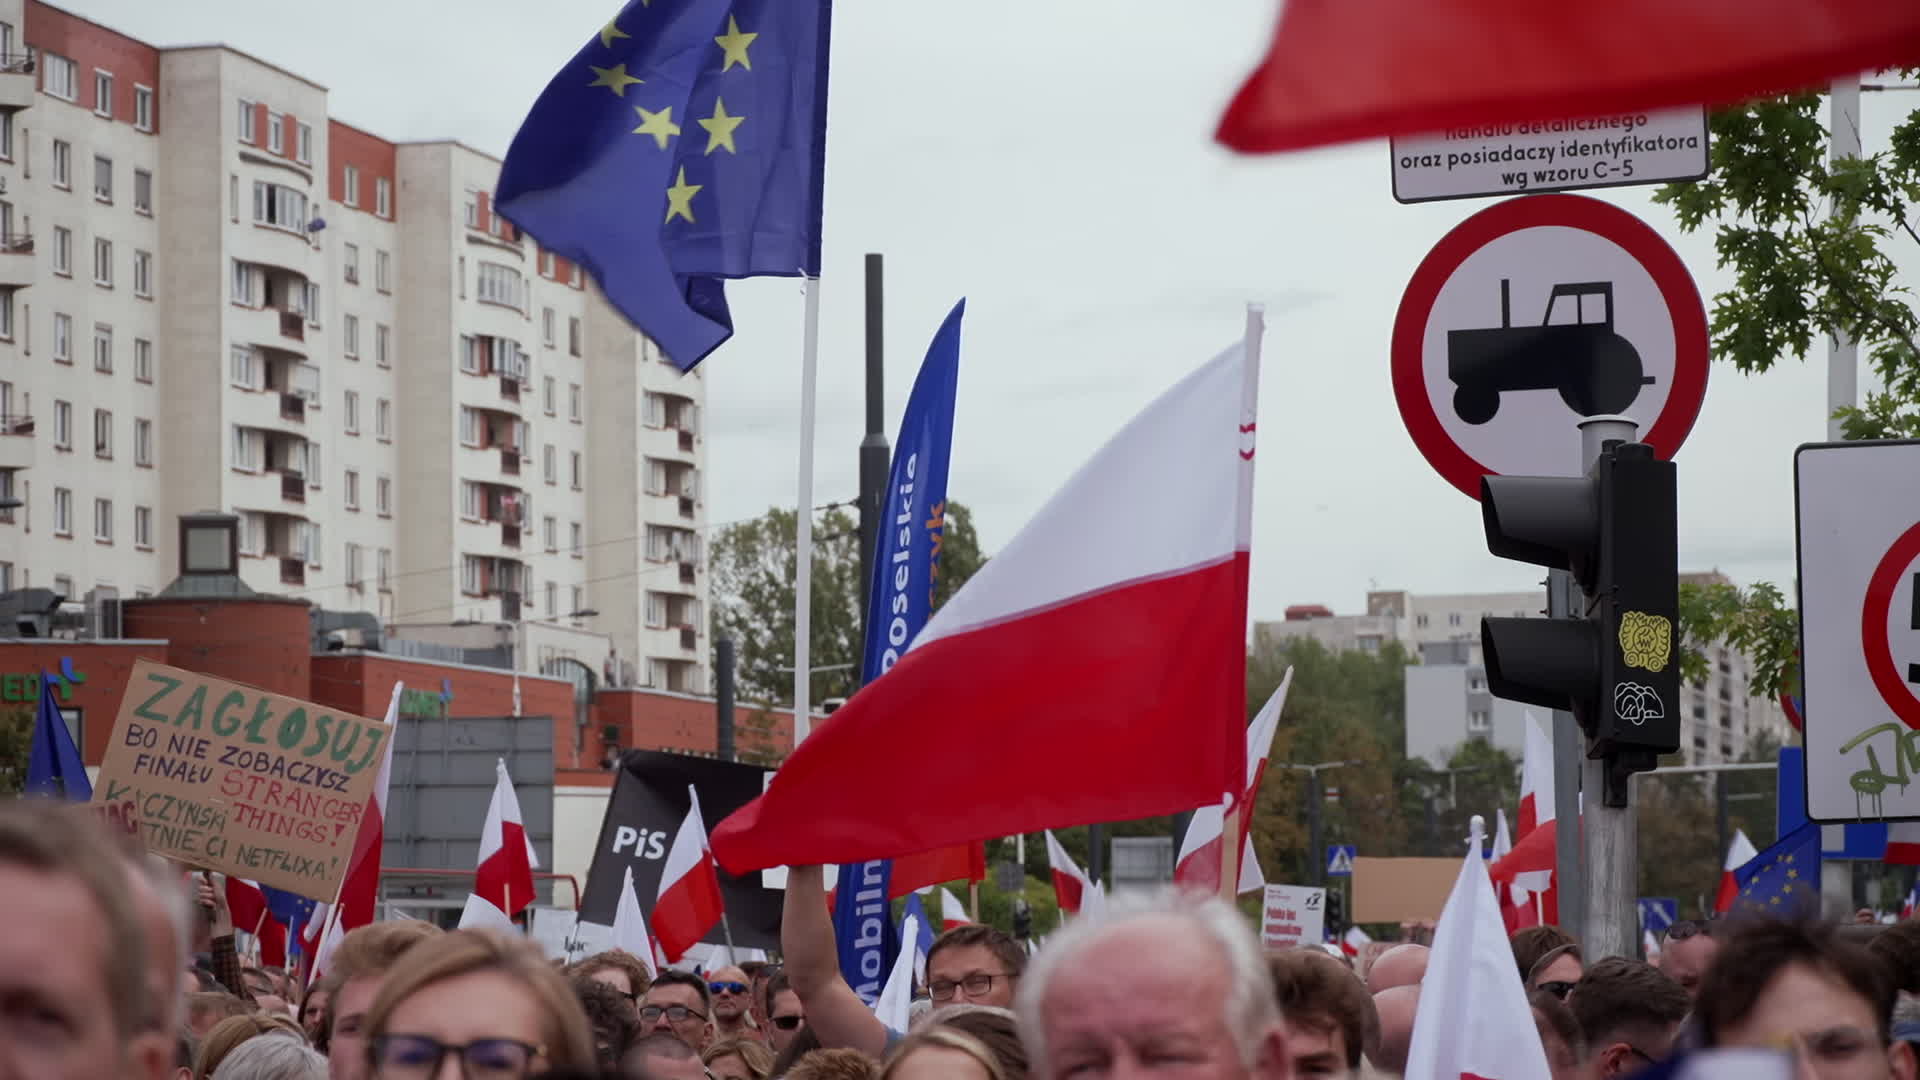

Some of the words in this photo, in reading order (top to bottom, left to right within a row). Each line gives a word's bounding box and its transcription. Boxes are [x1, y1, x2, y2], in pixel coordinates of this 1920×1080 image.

[1519, 113, 1648, 135] detalicznego
[1400, 154, 1442, 169] oraz
[1448, 144, 1556, 171] posiadaczy
[1560, 134, 1699, 159] identyfikatora
[1502, 172, 1528, 190] wg
[1533, 168, 1589, 183] wzoru
[1593, 159, 1634, 179] C-5
[0, 672, 41, 701] ED
[125, 723, 158, 749] BO
[167, 733, 211, 760] NIE
[218, 745, 351, 794] ZOBACZYSZ
[133, 753, 214, 784] FINAŁU
[221, 769, 362, 826] STRANGER
[233, 802, 345, 848] THINGS!
[612, 825, 667, 860] PiS
[206, 836, 228, 858] CI
[854, 859, 882, 1009] Mobiln
